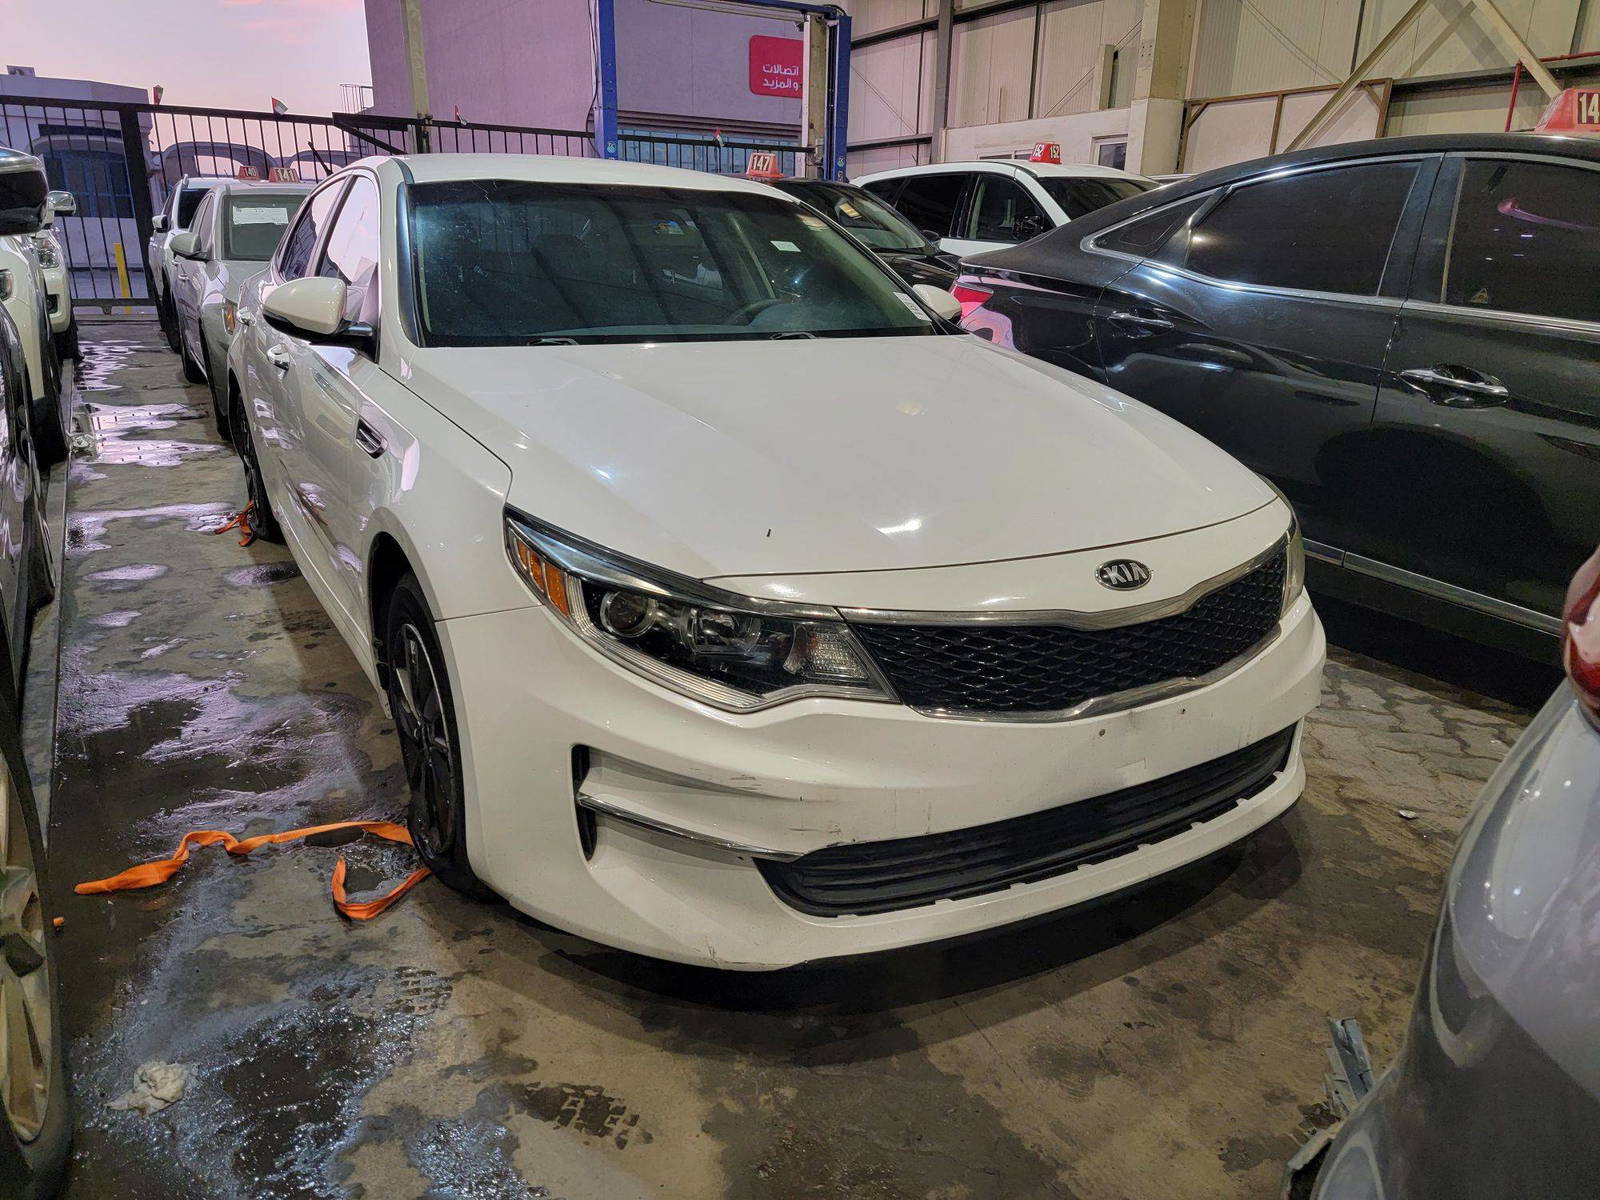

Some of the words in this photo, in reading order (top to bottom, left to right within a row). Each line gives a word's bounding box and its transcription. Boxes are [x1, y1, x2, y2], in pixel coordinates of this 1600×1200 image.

[763, 64, 799, 76] اتصالات
[753, 155, 770, 171] 147
[1104, 562, 1147, 584] KIA
